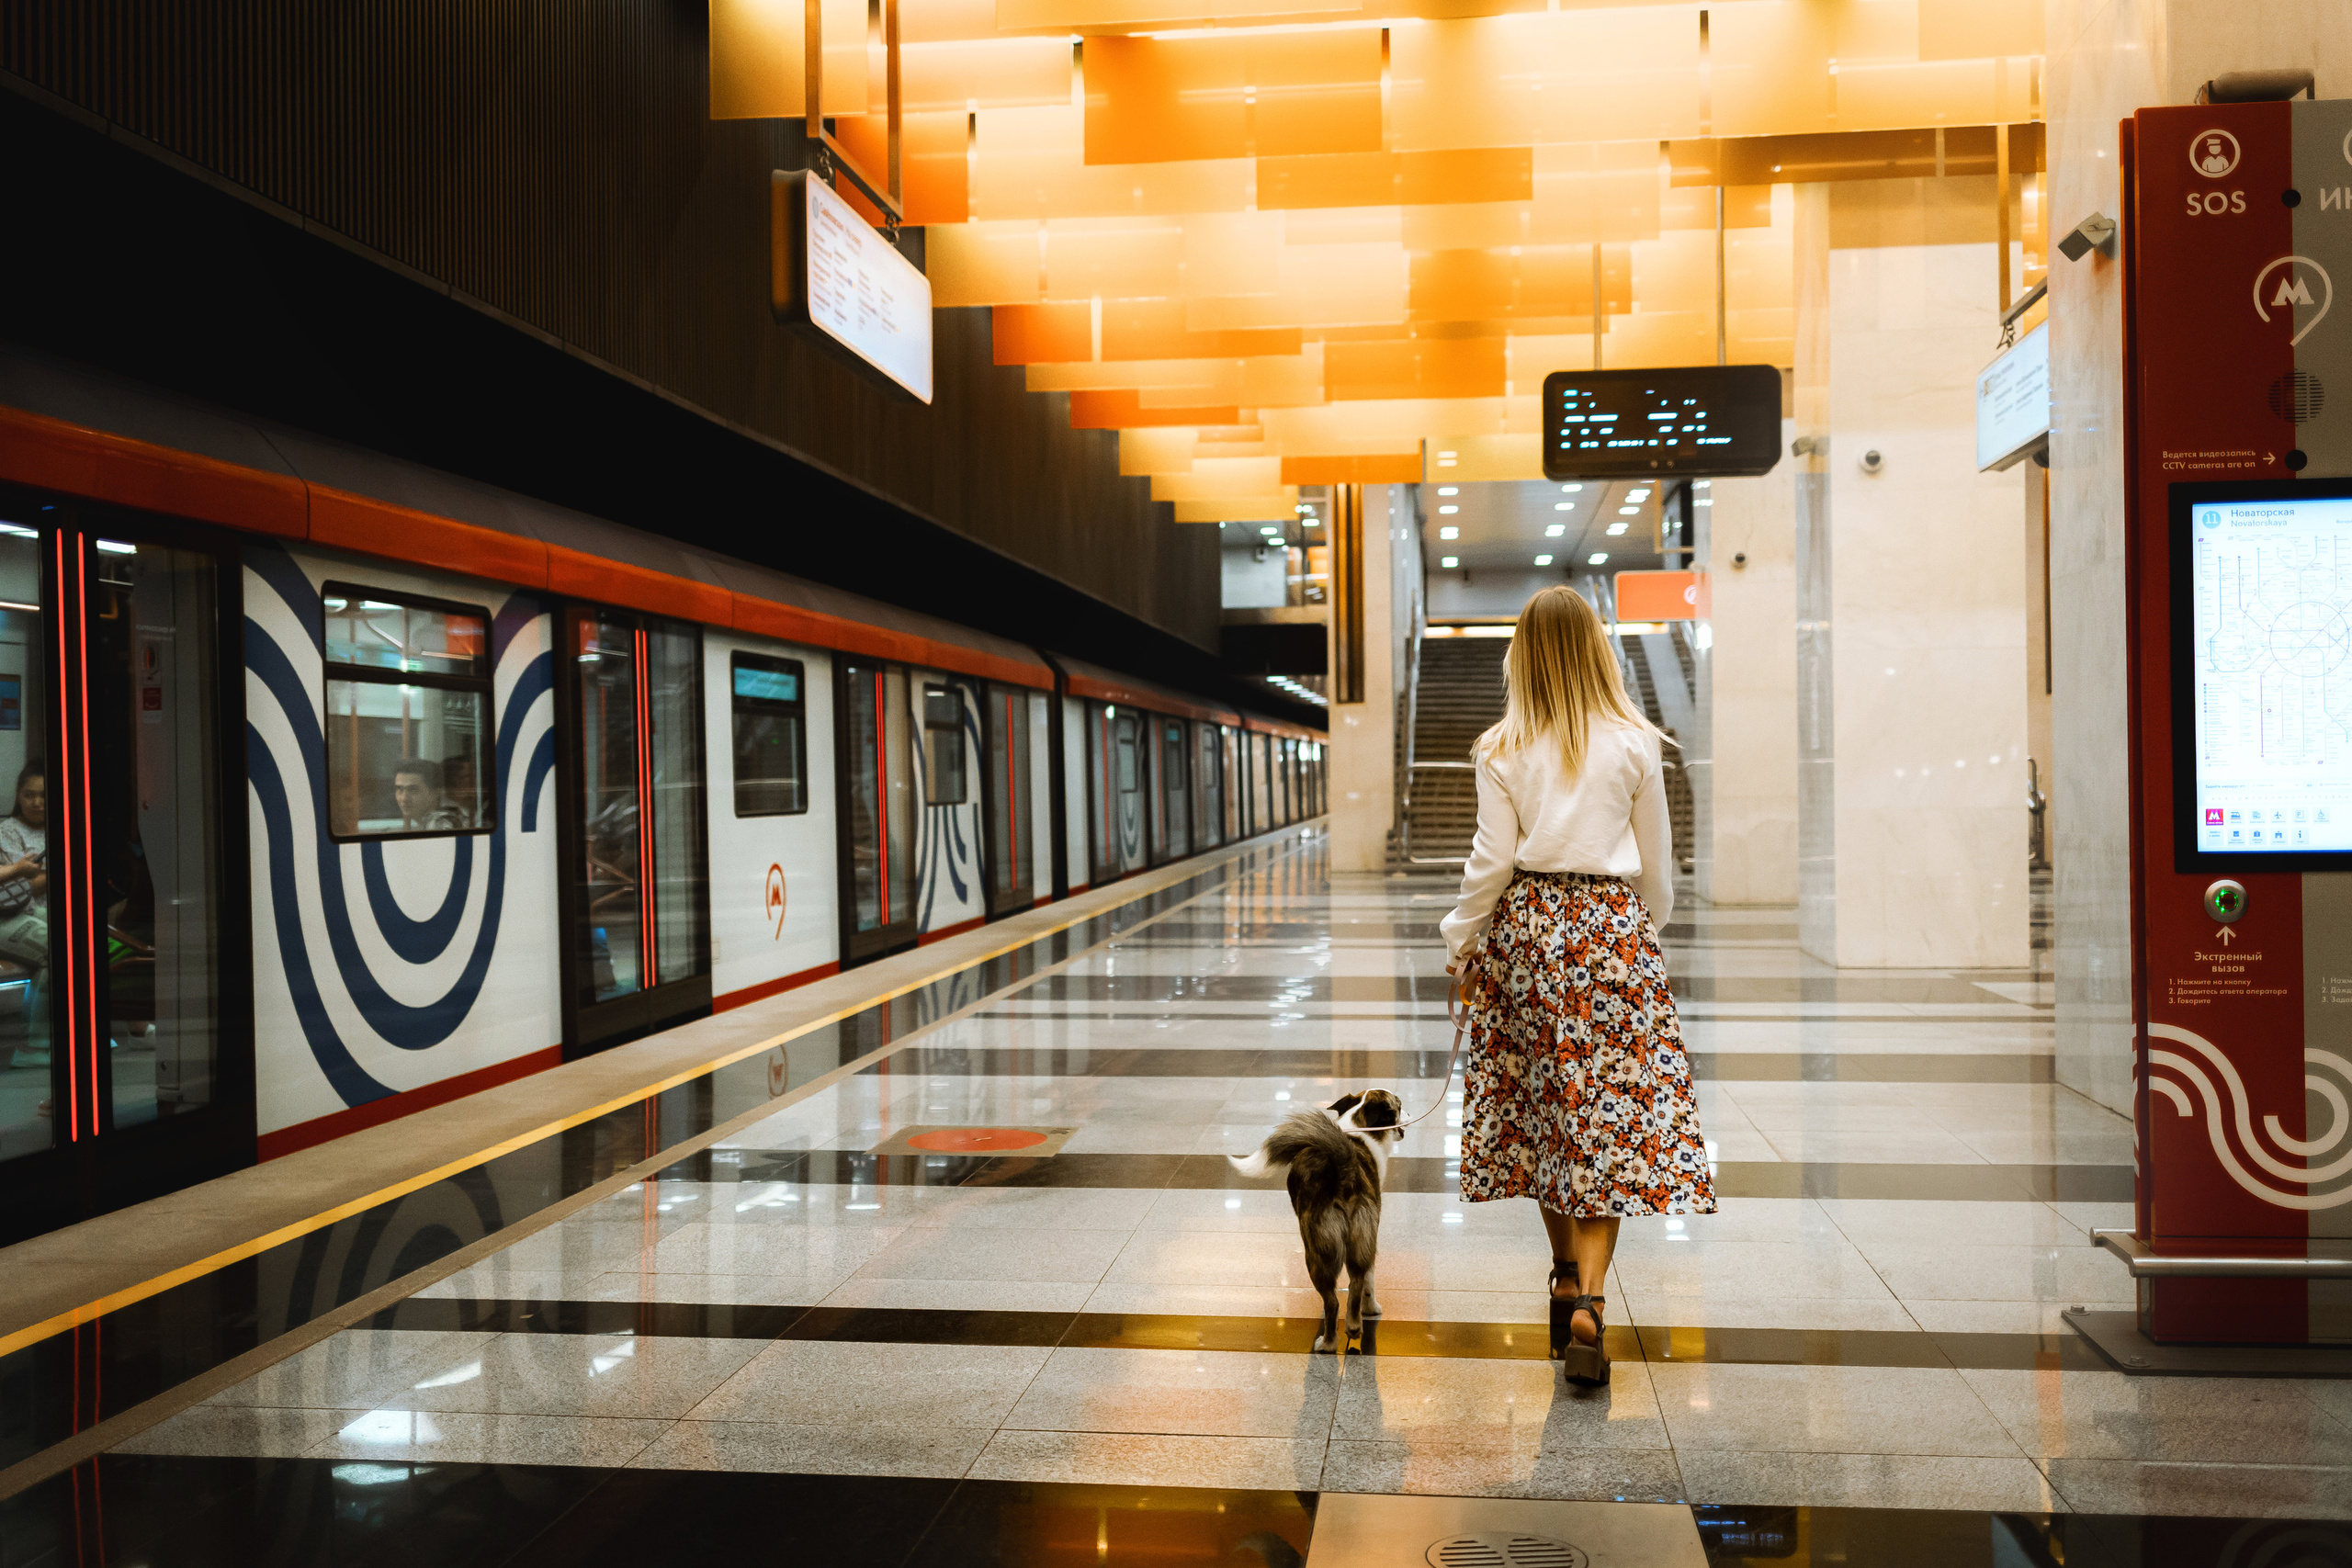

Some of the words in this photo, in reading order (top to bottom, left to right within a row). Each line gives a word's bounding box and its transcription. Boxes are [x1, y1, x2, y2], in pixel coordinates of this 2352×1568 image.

[2186, 190, 2246, 216] SOS
[2162, 450, 2197, 459] Ведется
[2199, 450, 2256, 459] видеозапись
[2162, 461, 2186, 470] CCTV
[2231, 508, 2295, 518] Новаторская
[2205, 513, 2218, 525] 11
[2231, 519, 2288, 527] Novatorskaya
[2194, 951, 2263, 964] Экстренный
[2223, 979, 2252, 987] кнопку
[2177, 987, 2219, 996] Дождитесь
[2177, 997, 2211, 1006] Говорите
